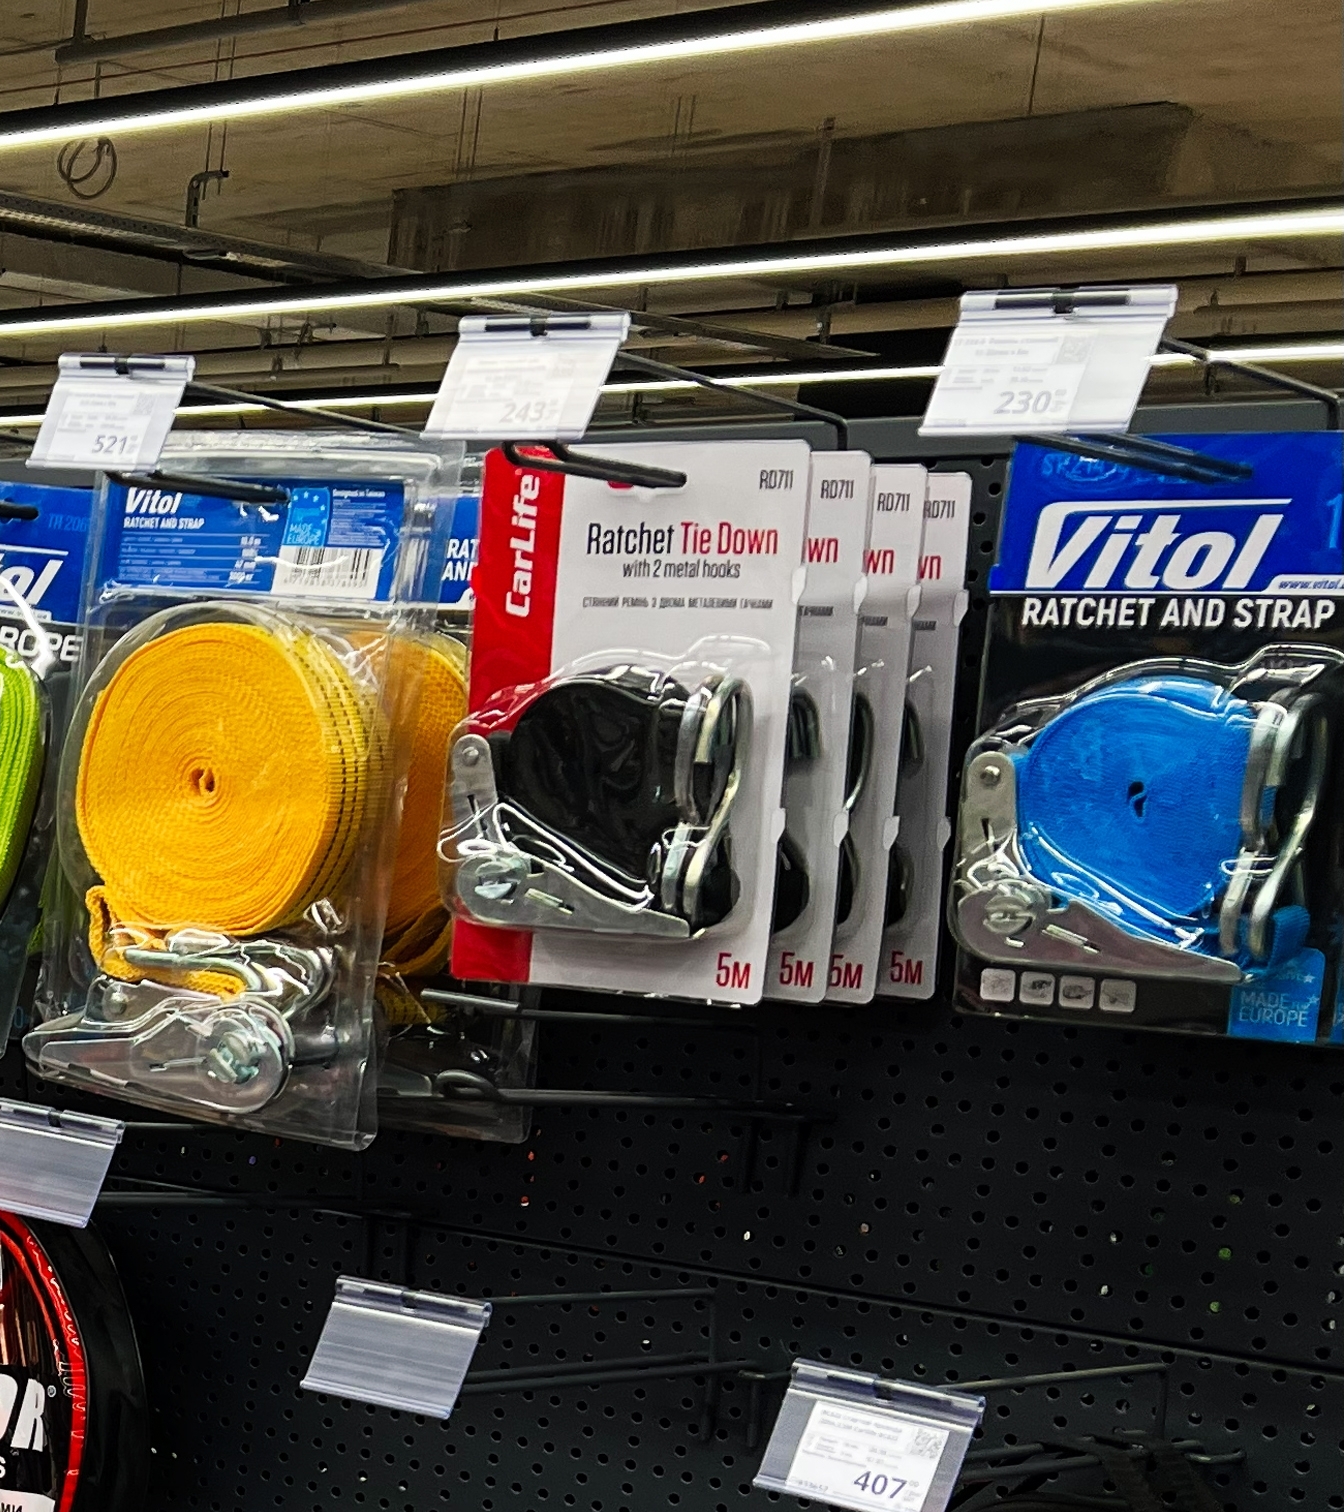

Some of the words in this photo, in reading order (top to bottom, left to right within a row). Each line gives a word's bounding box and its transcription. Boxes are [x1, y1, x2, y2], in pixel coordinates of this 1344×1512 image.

[499, 400, 545, 424] 243
[994, 390, 1052, 415] 230
[92, 435, 127, 454] 521
[760, 470, 794, 490] RD711
[124, 486, 184, 514] Vitol
[505, 474, 542, 617] CarLife
[587, 522, 675, 556] Ratchet
[680, 521, 712, 555] Tie
[717, 521, 779, 556] Down
[1025, 499, 1292, 592] Vitol
[623, 559, 652, 578] with
[653, 561, 662, 578] 2
[664, 559, 701, 578] metal
[702, 559, 741, 579] hooks
[1022, 598, 1153, 628] RATCHET
[1160, 598, 1223, 628] AND
[1233, 599, 1336, 629] STRAP
[854, 1470, 908, 1500] 407
